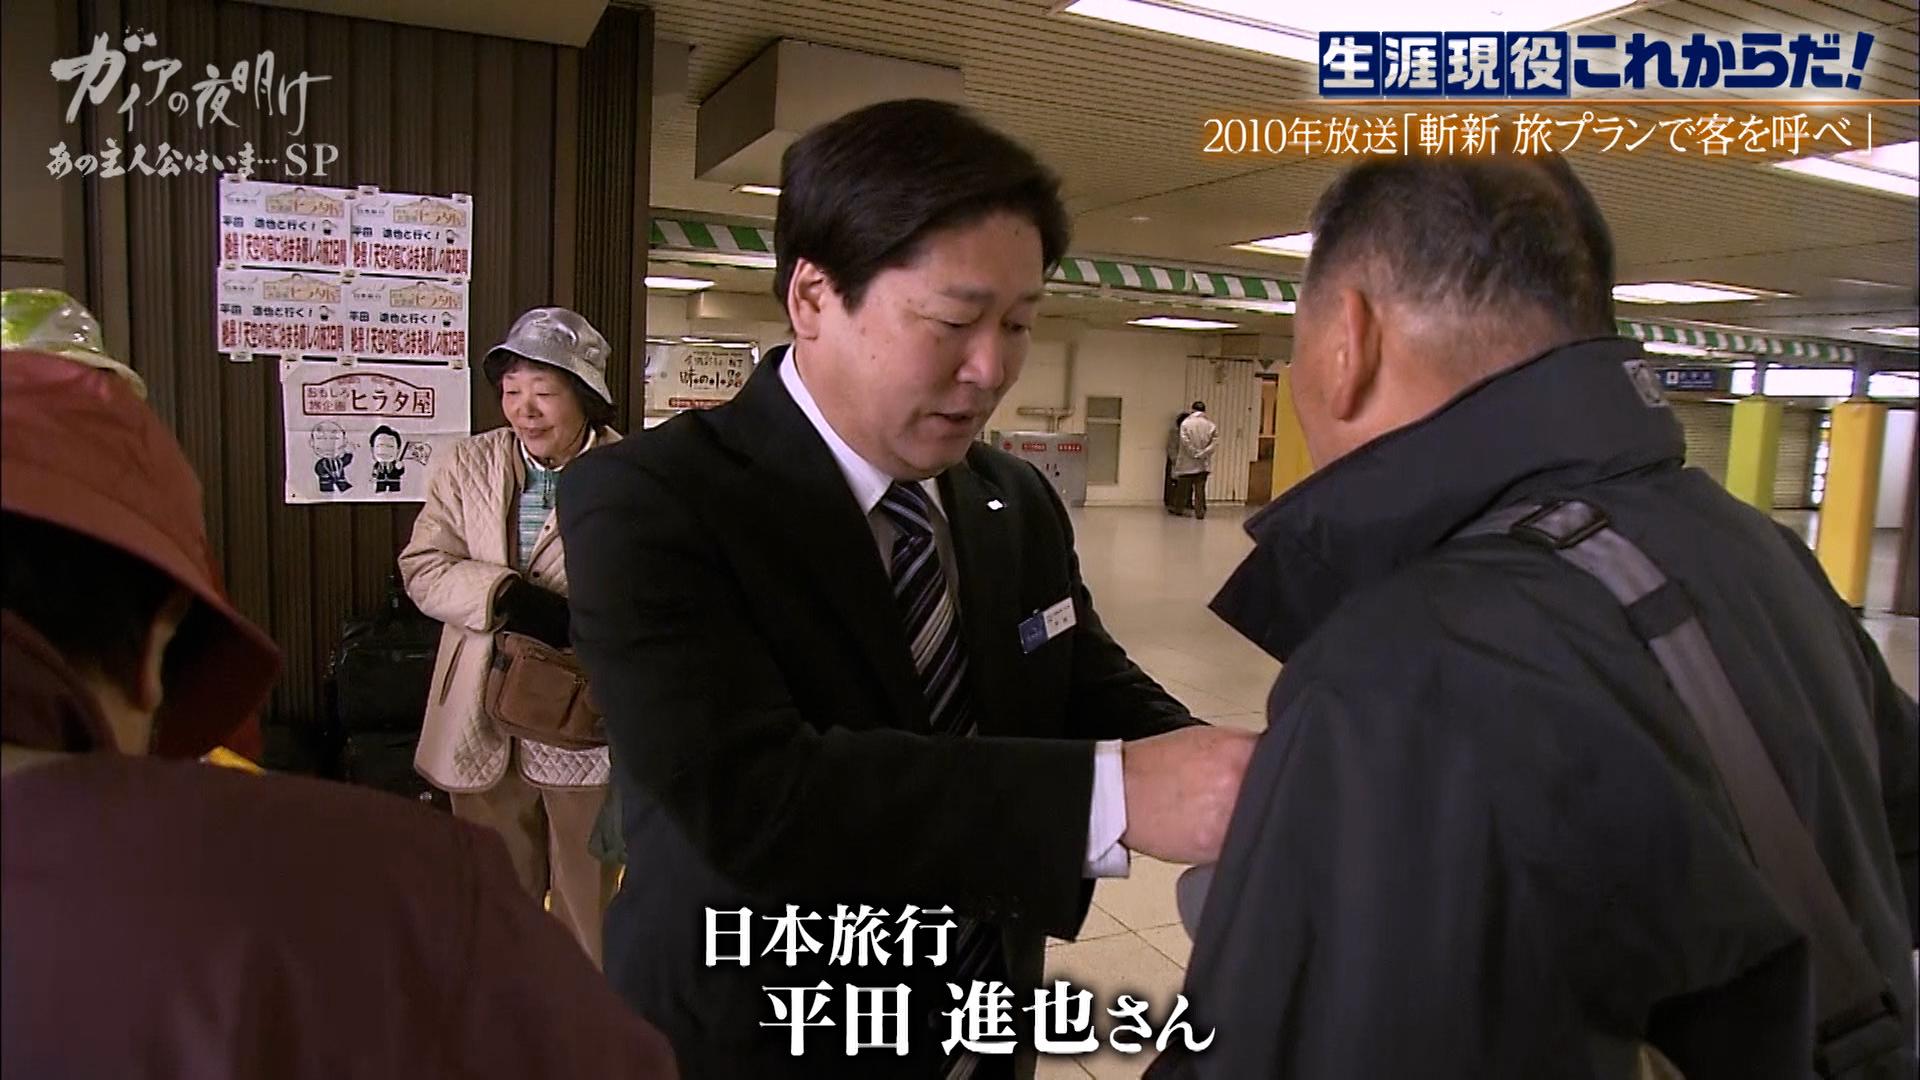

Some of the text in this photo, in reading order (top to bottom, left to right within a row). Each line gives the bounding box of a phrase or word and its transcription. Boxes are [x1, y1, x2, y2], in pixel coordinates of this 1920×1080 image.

[307, 387, 350, 398] おもしろ
[308, 400, 346, 412] 旅企画
[351, 389, 431, 414] ヒラタ屋
